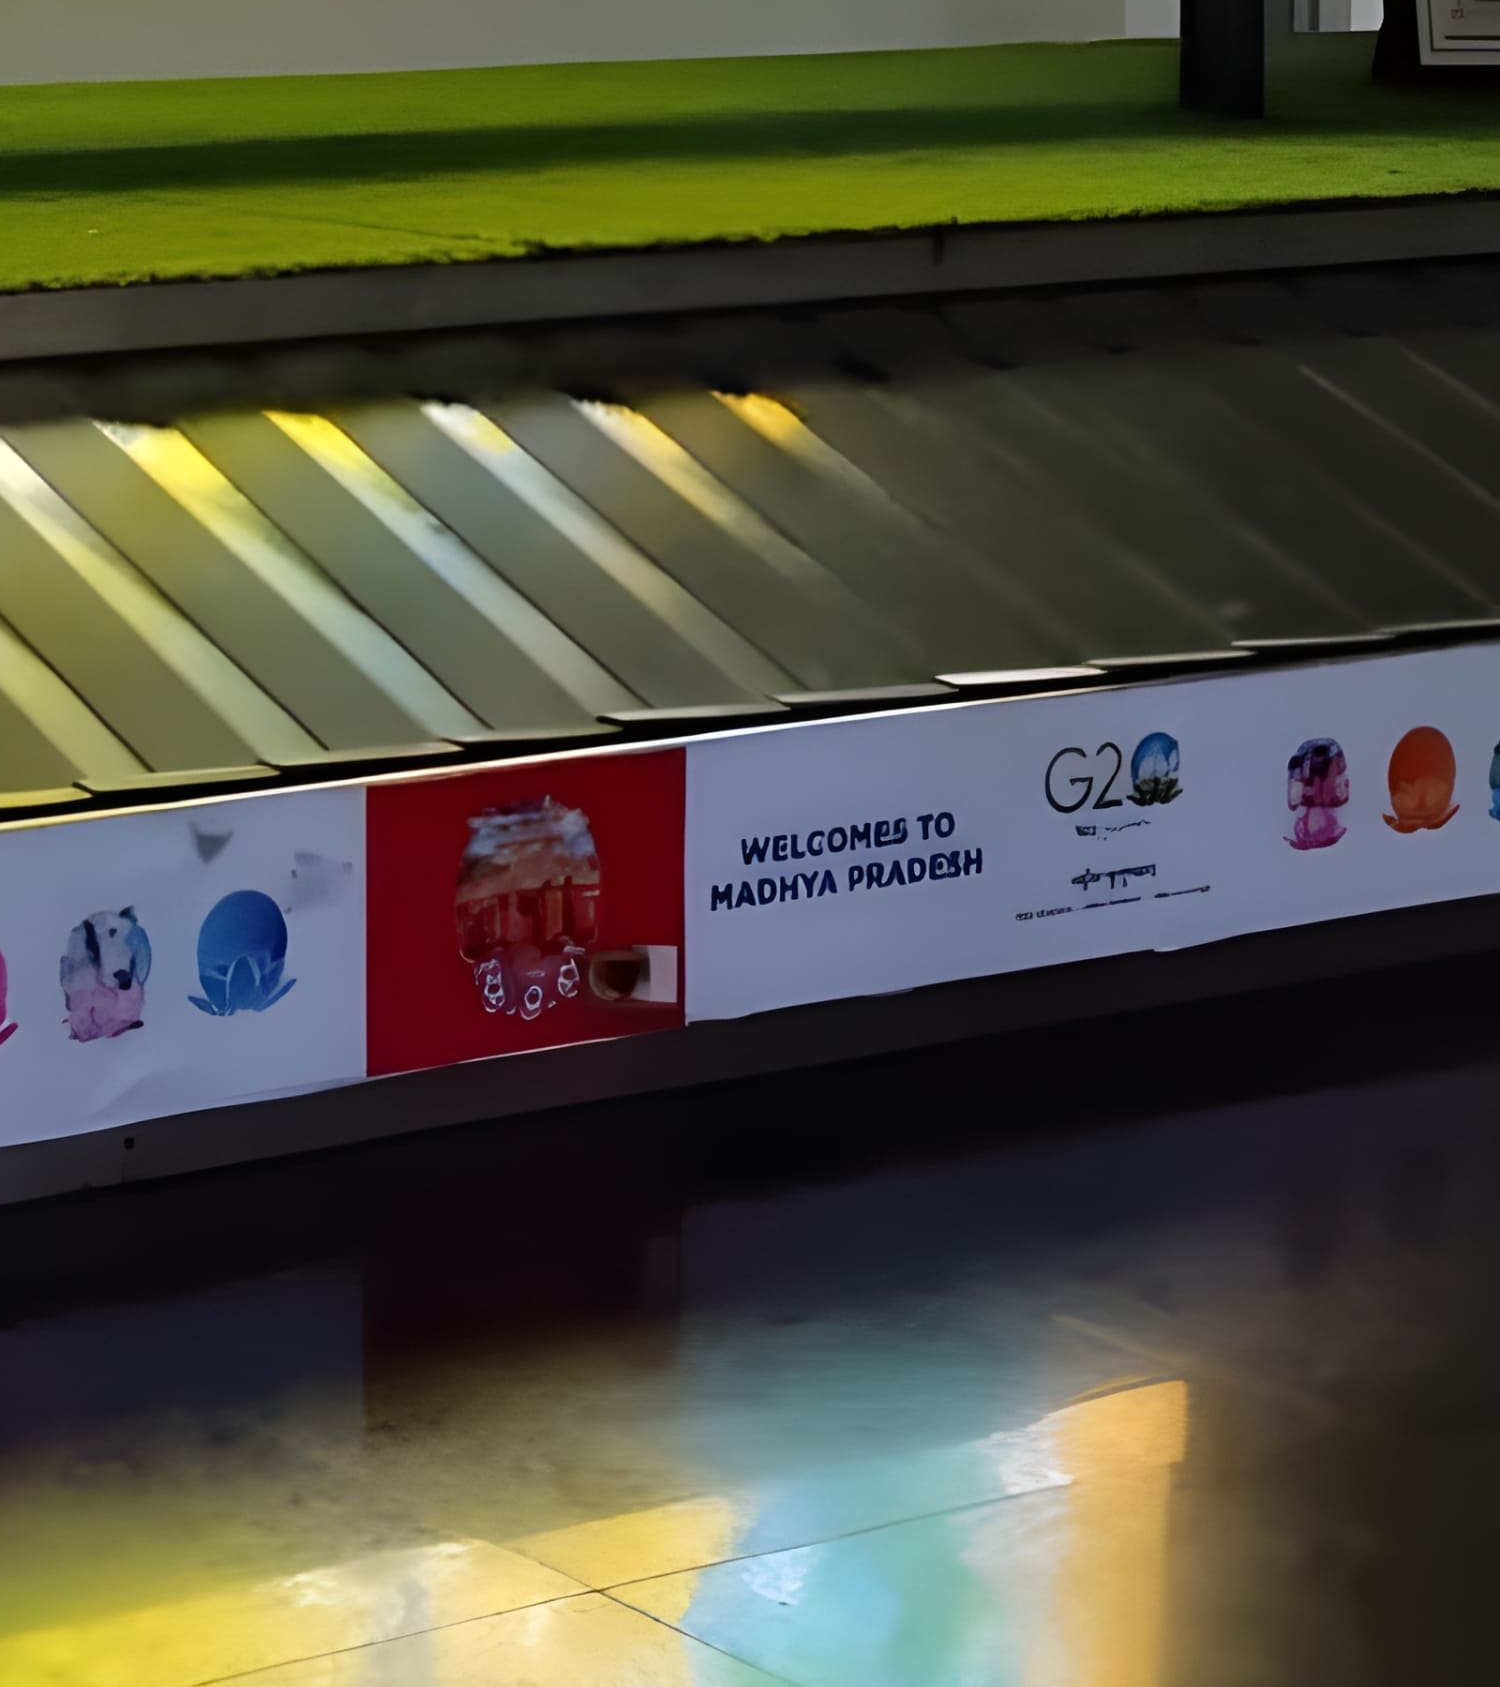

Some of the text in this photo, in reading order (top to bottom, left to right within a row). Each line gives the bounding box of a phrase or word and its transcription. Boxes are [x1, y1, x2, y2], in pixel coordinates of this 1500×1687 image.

[741, 811, 956, 865] WELCOMES TO
[711, 848, 983, 912] MADHYA PRADESH
